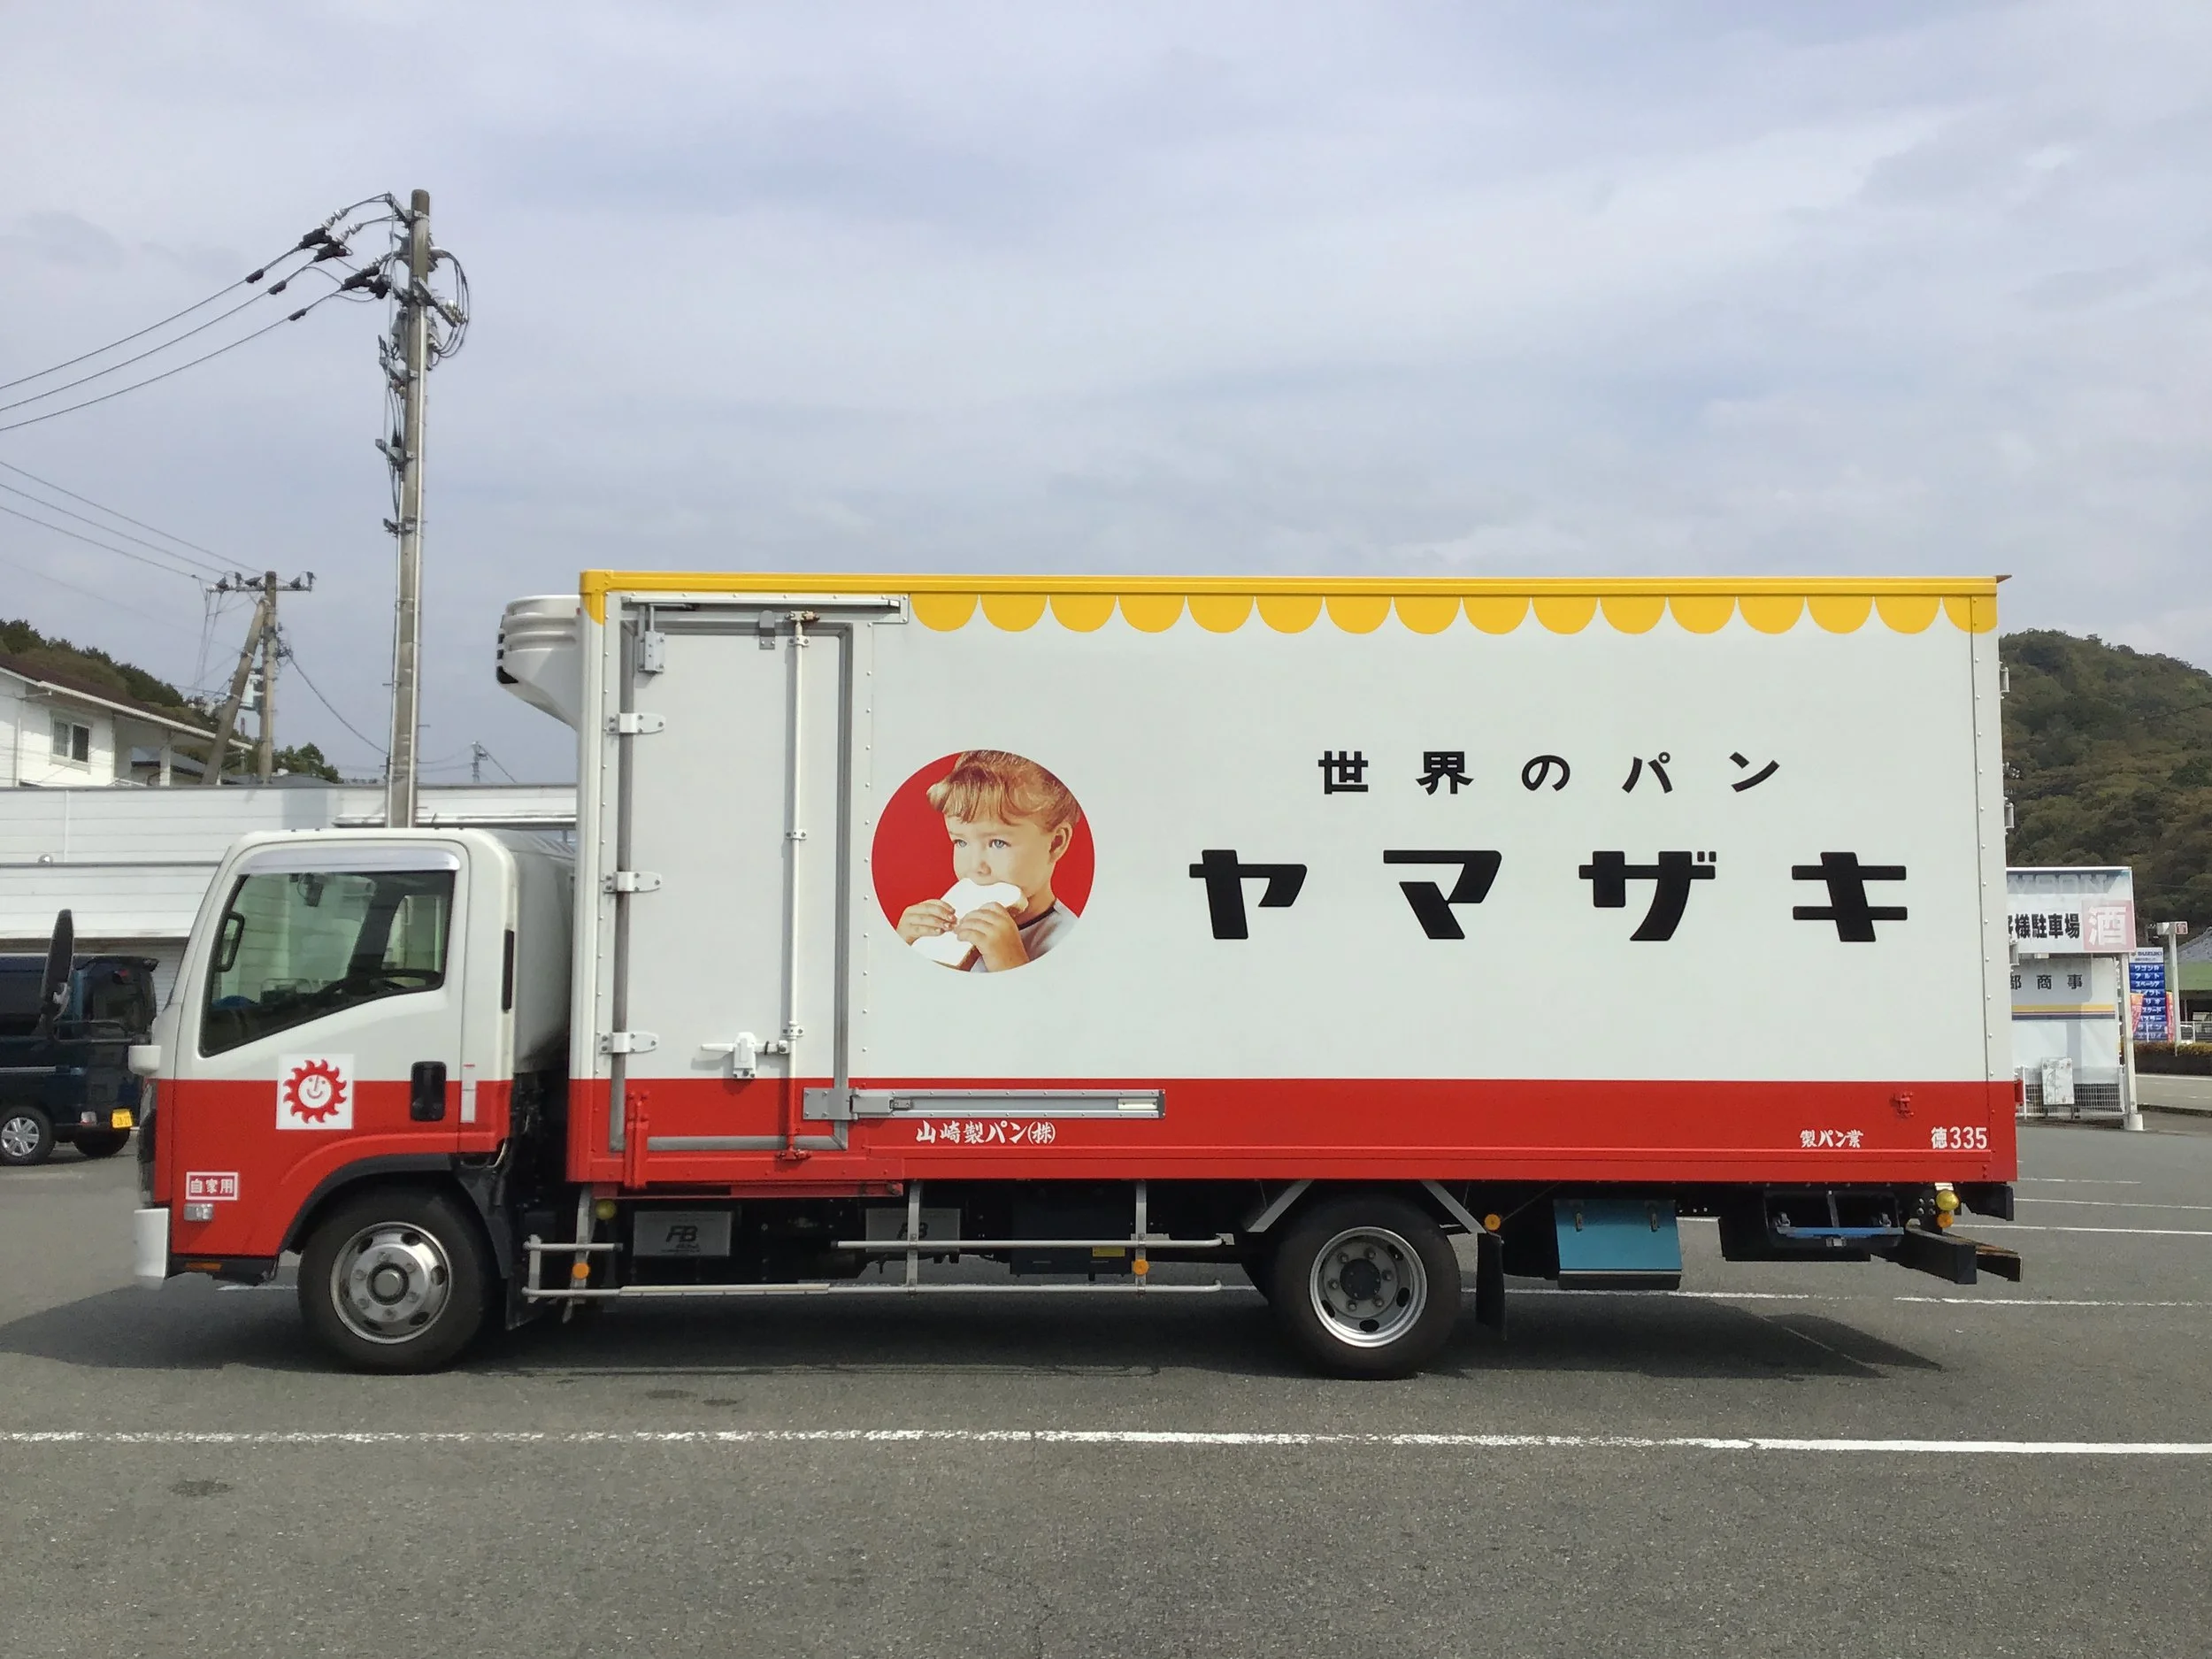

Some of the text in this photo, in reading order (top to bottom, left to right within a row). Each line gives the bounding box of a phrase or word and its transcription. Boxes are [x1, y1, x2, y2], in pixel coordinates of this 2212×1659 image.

[1318, 750, 1780, 795] 世界のパン
[1189, 849, 1908, 942] ヤマザキ
[2089, 906, 2127, 945] 酒
[916, 1119, 1056, 1145] 山崎製パン(株)
[1800, 1129, 1863, 1148] 製パン業
[1931, 1126, 1987, 1150] 徳335
[190, 1179, 234, 1194] 自家用
